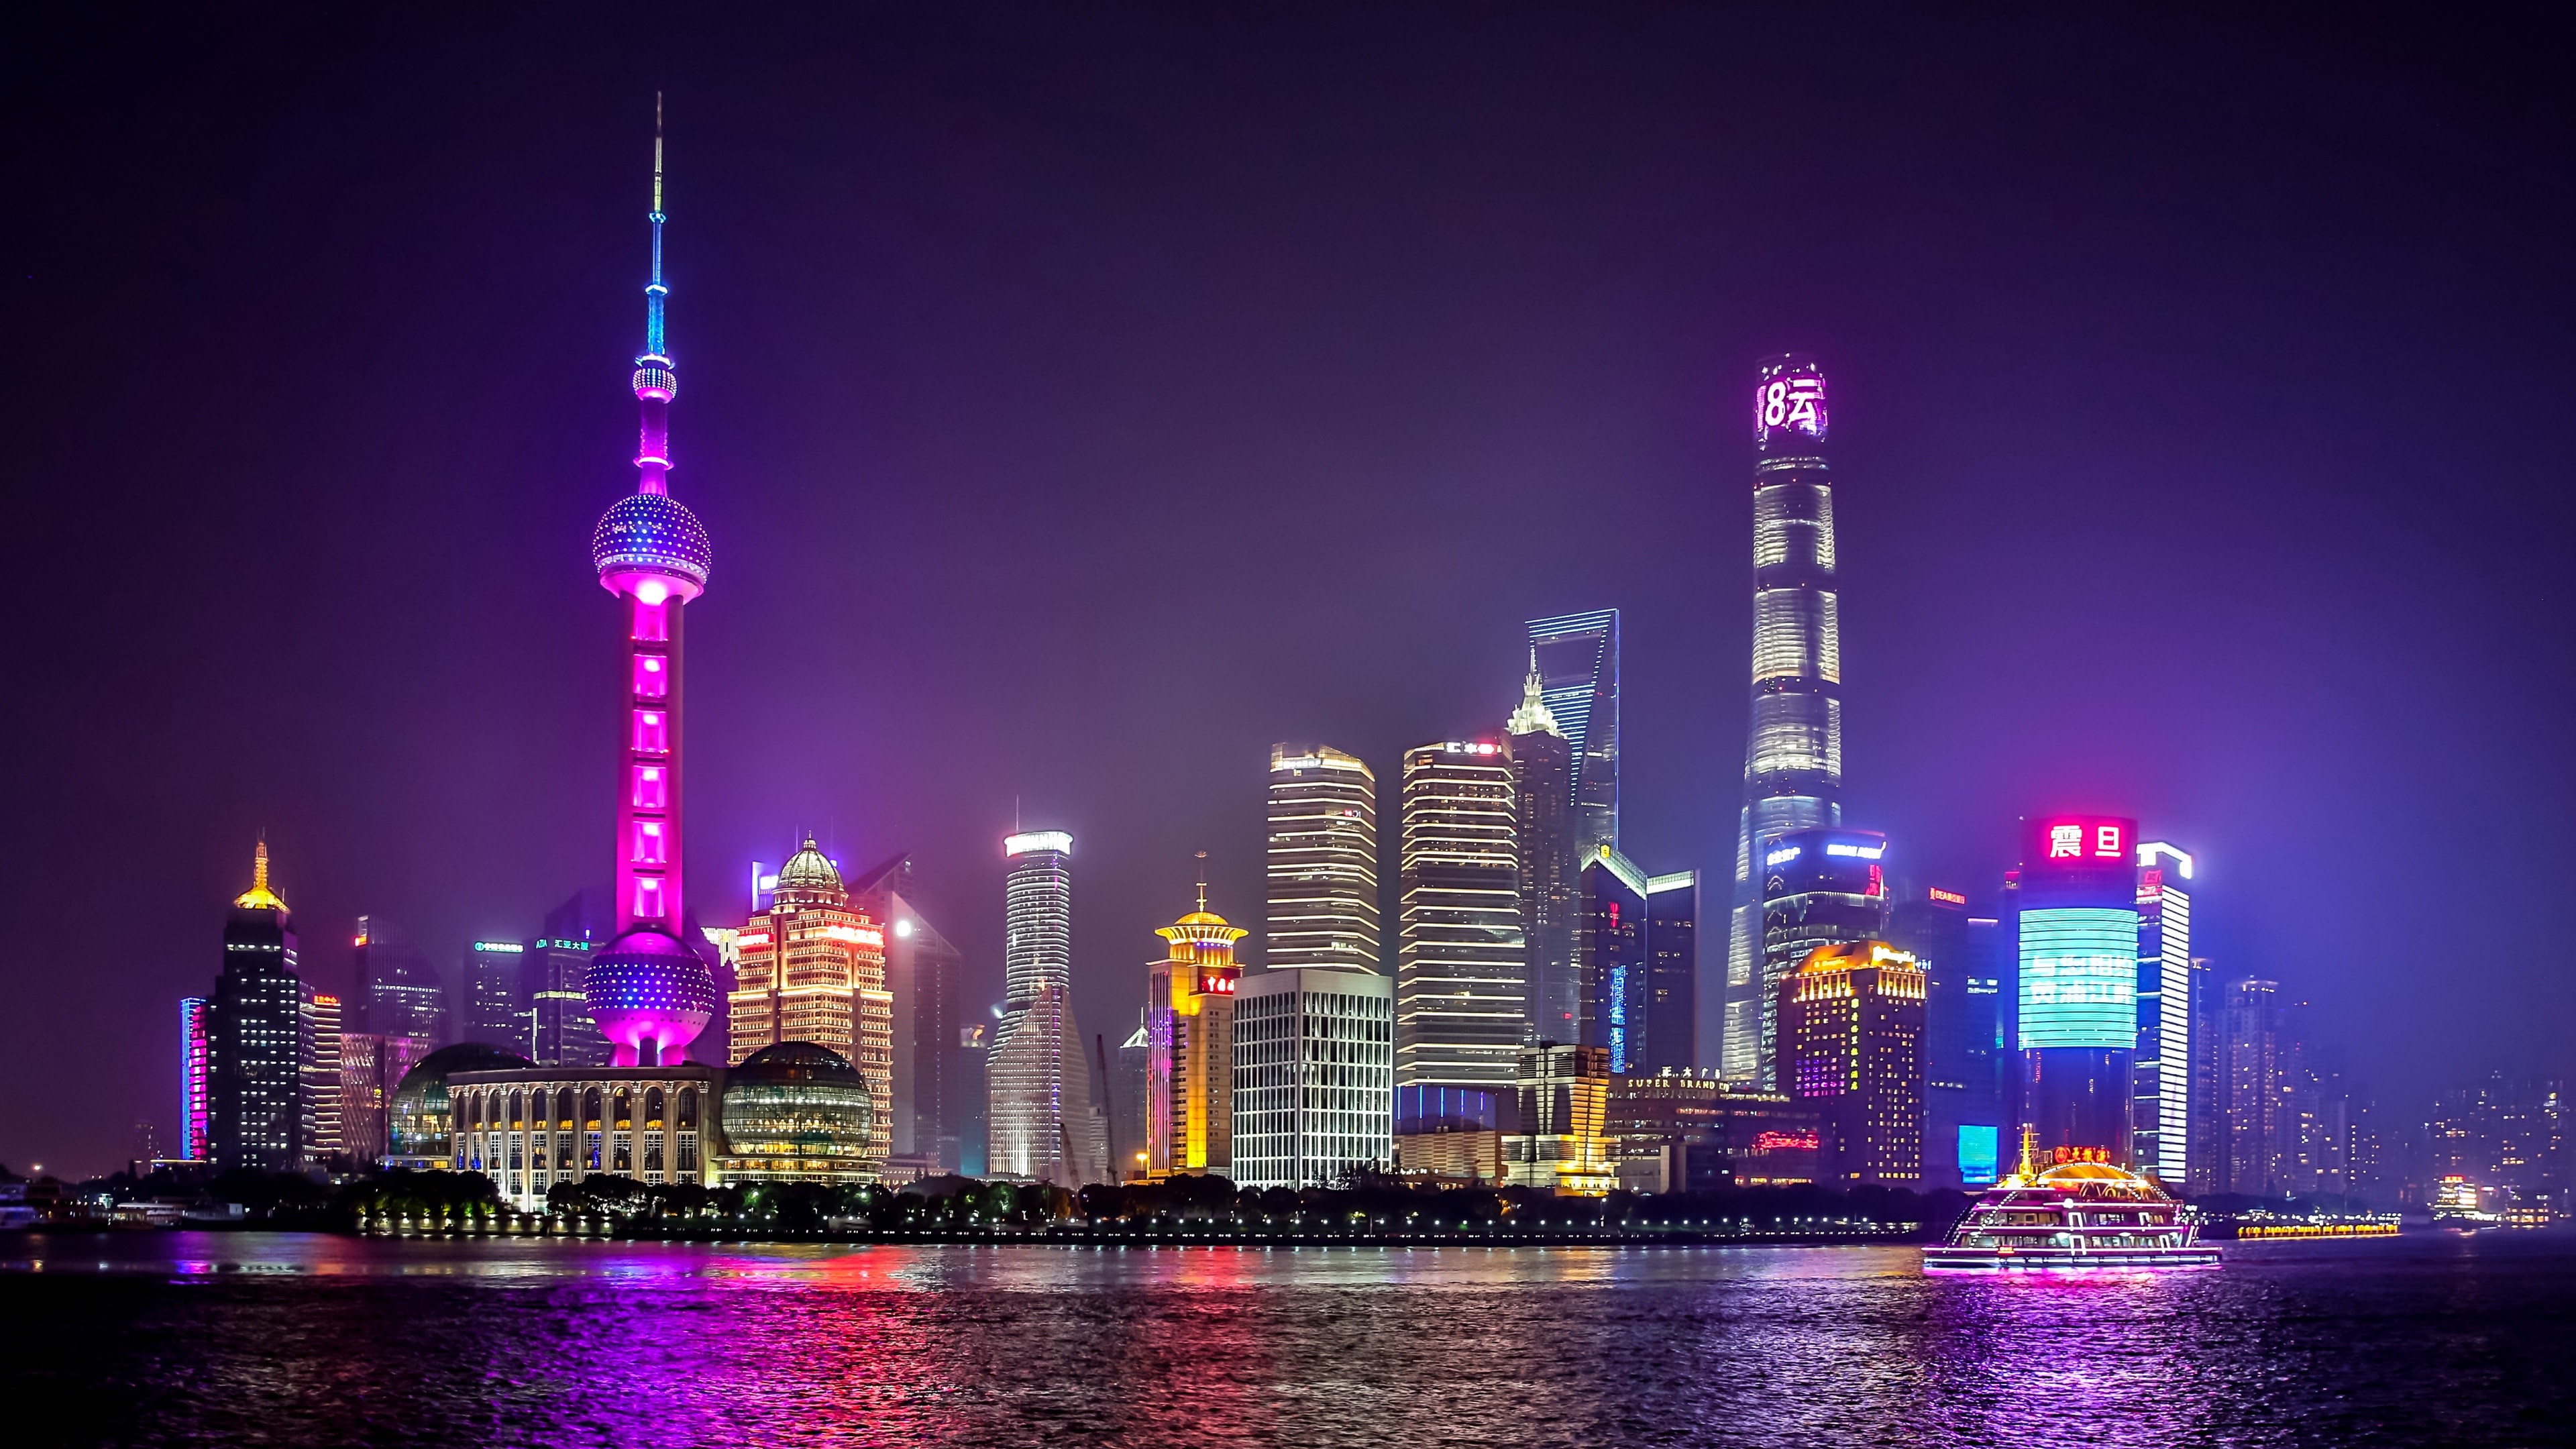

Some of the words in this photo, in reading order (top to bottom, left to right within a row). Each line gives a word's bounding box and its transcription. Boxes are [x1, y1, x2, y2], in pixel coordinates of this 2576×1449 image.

[2049, 825, 2121, 858] 震旦
[554, 939, 590, 951] 汇亚大厦
[1628, 1079, 1670, 1087] SUPER
[1680, 1079, 1715, 1089] BRAND
